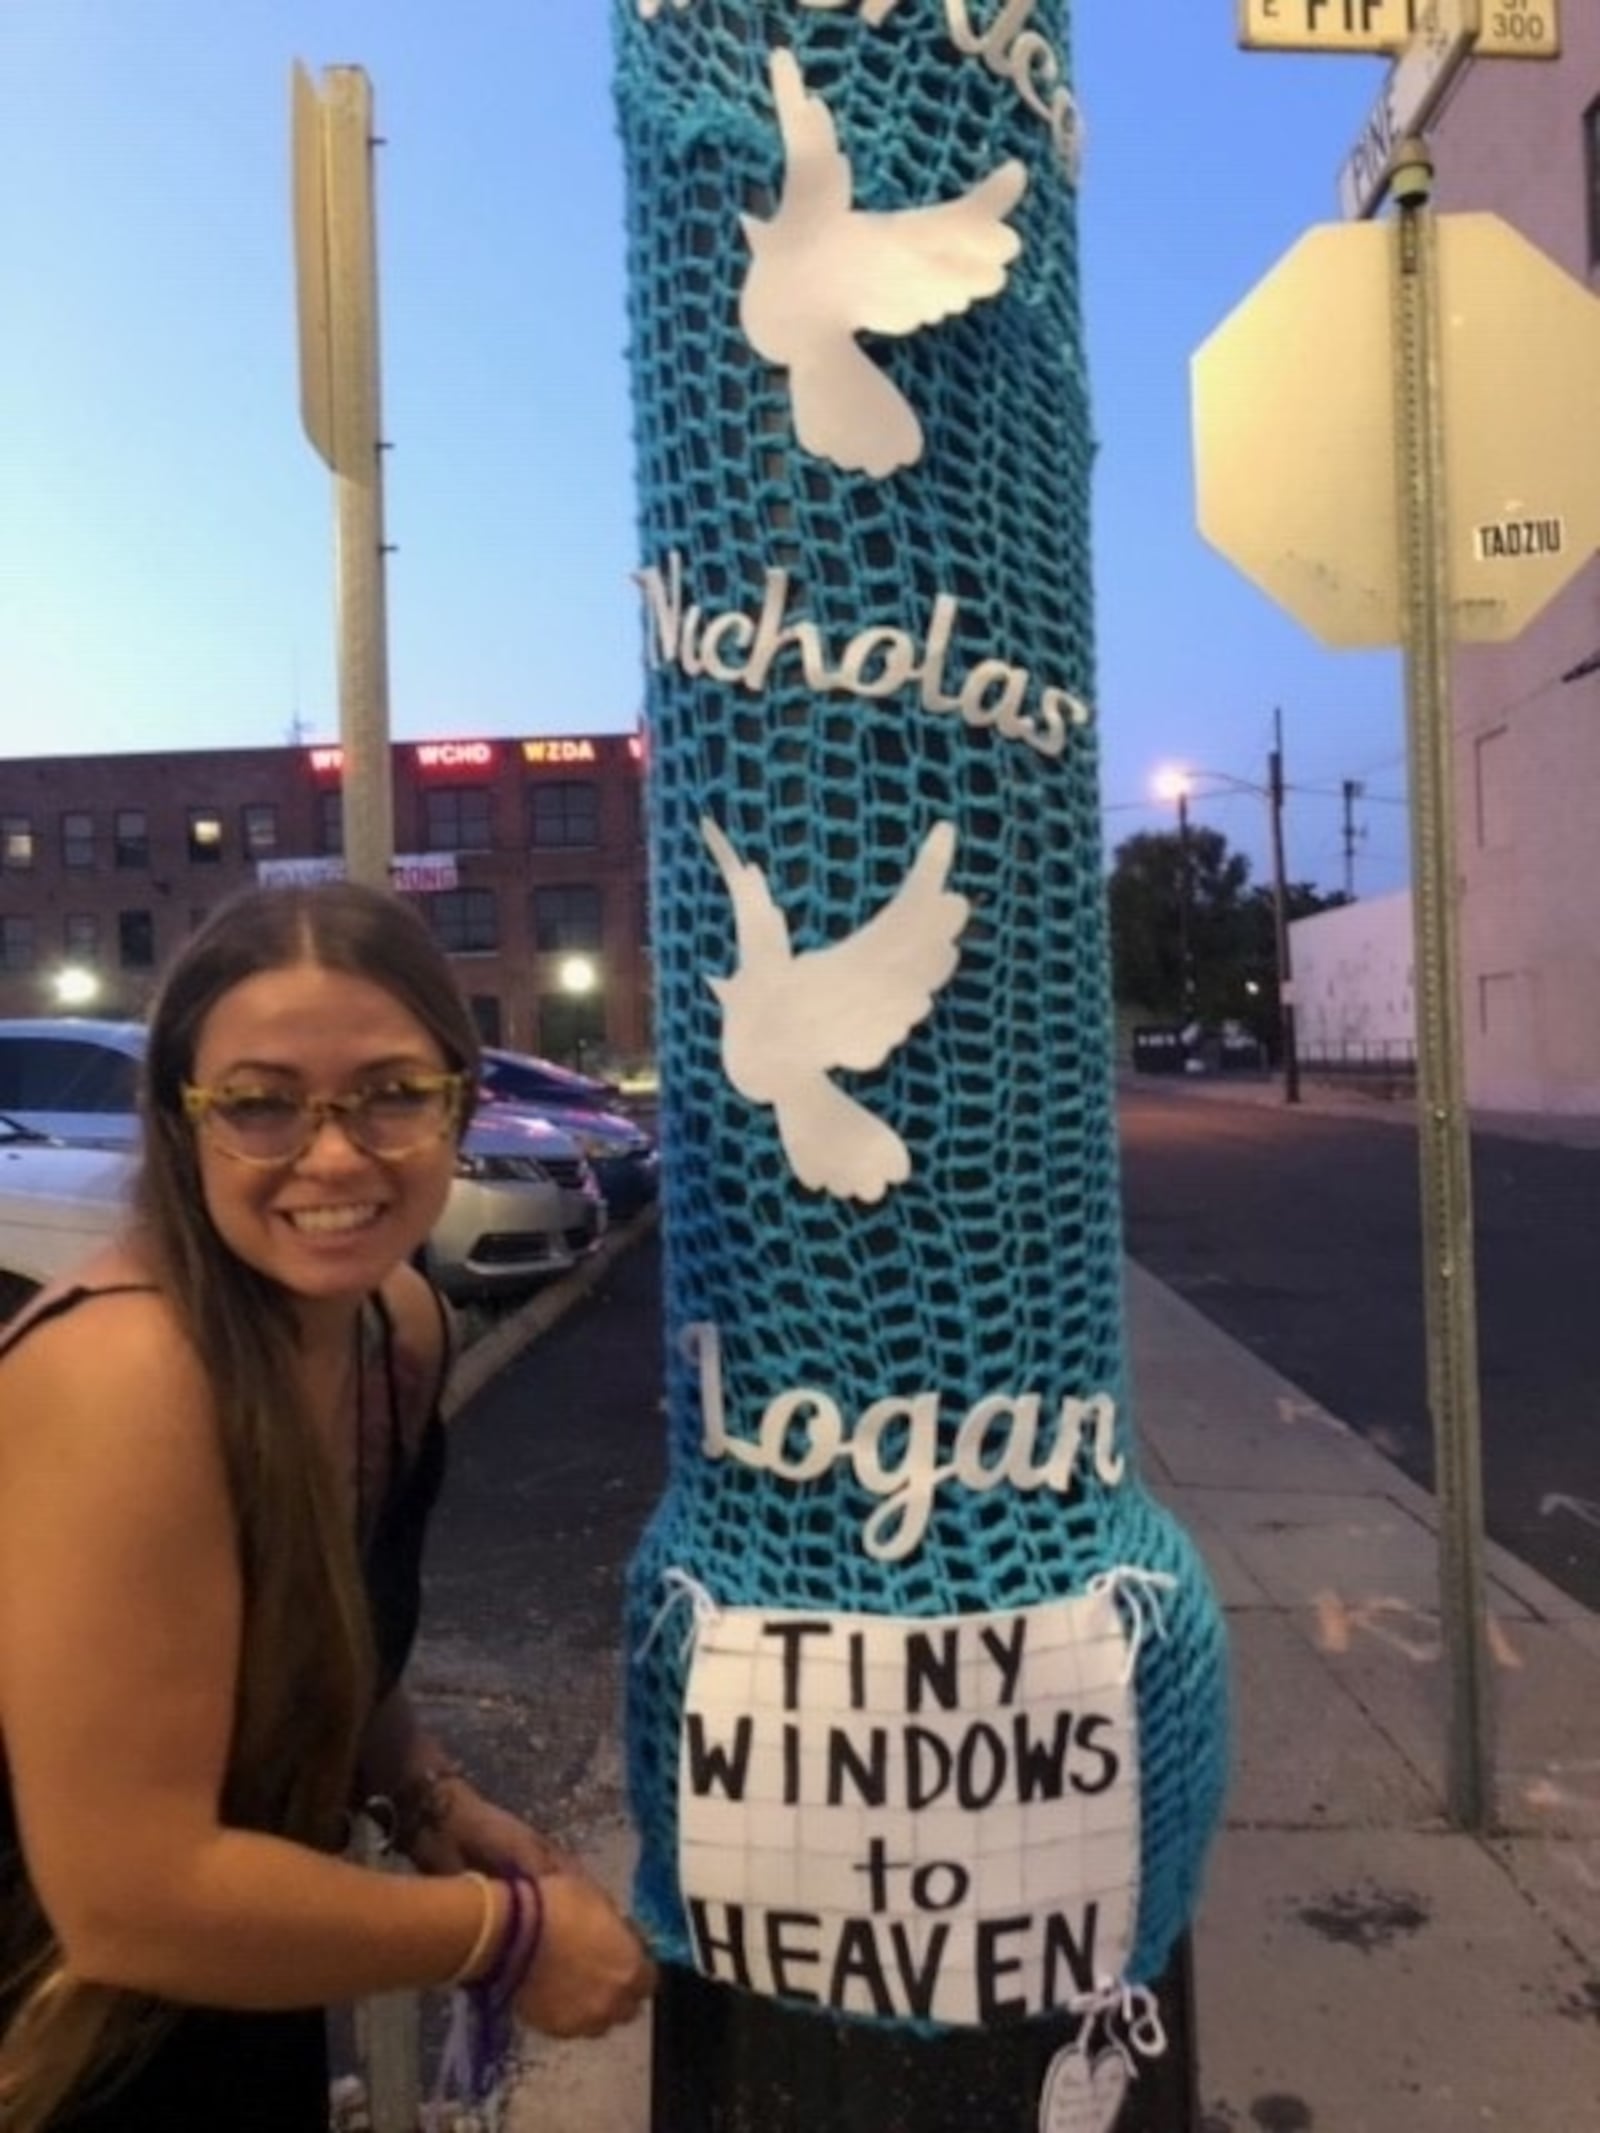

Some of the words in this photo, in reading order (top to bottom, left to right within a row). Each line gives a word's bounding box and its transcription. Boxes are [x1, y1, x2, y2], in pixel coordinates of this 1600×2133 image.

[1492, 14, 1545, 39] 300
[633, 550, 1088, 757] Nicholas
[523, 741, 594, 761] WZDA
[680, 1321, 1124, 1561] Logan
[763, 1617, 1027, 1712] TINY
[687, 1712, 1119, 1810] WINDOWS
[853, 1838, 970, 1912] to
[689, 1899, 1098, 2024] HEAVEN
